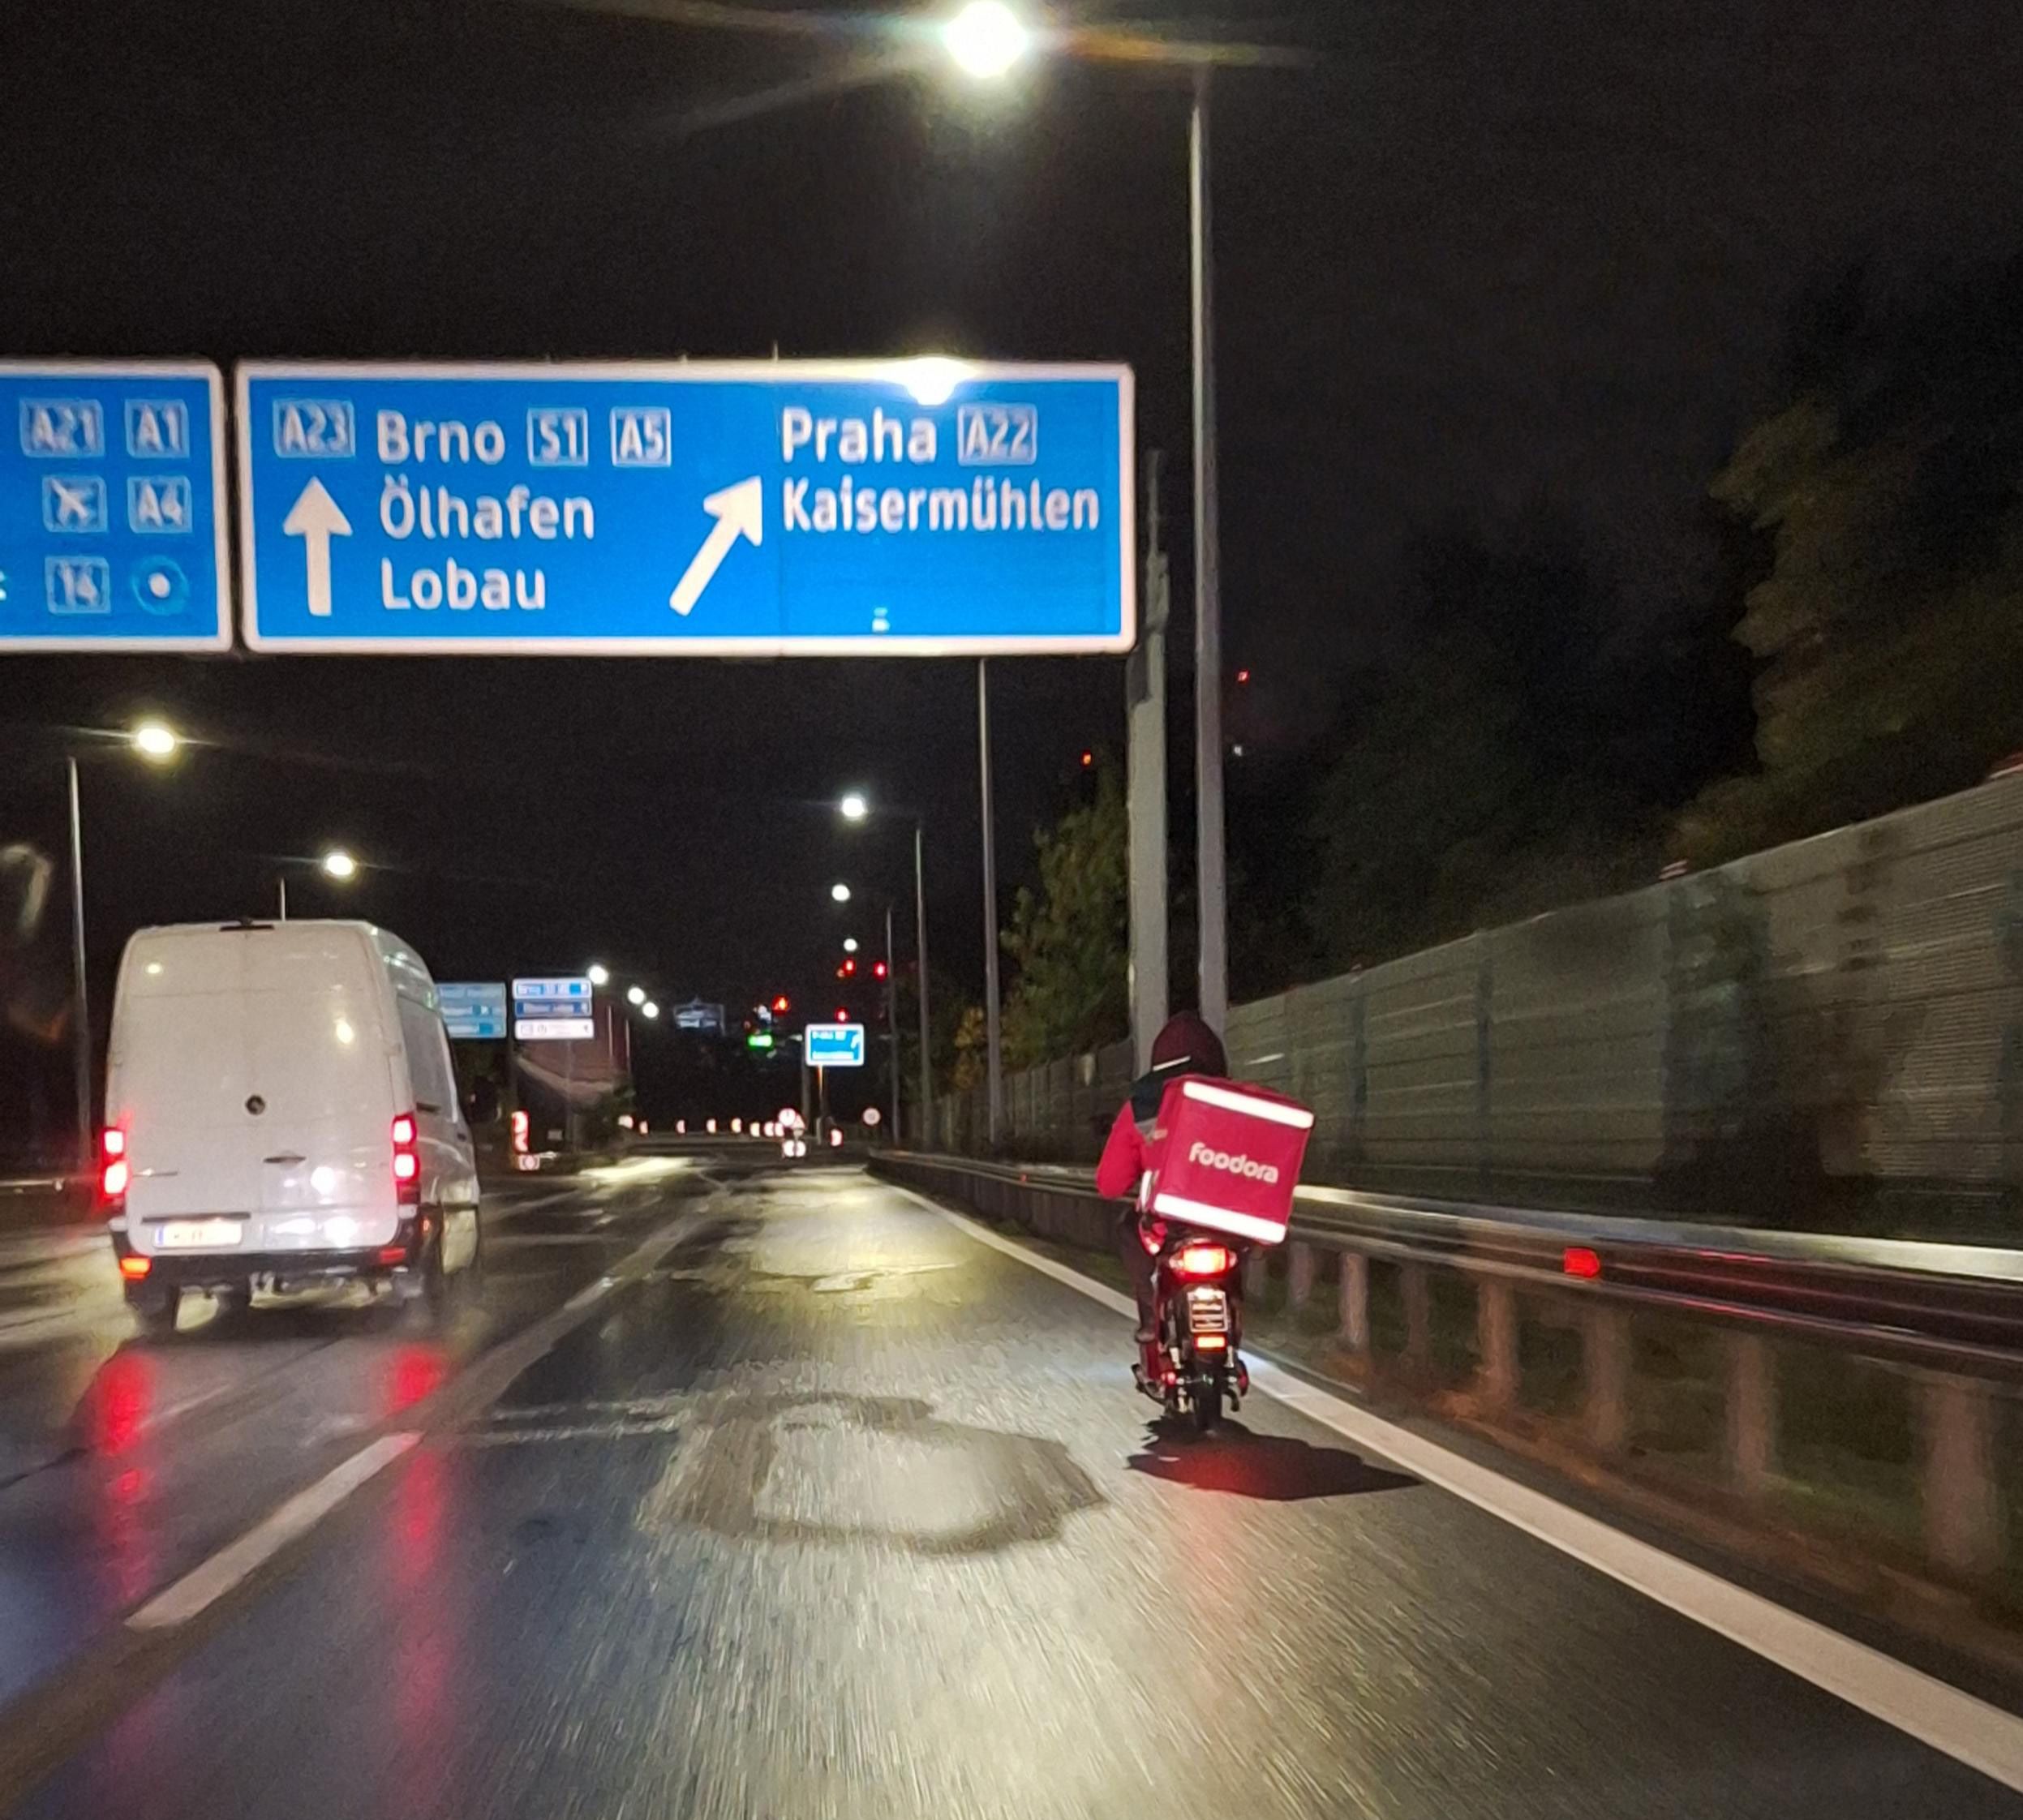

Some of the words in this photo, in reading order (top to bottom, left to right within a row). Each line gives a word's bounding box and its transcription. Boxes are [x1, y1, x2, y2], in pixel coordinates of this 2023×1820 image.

[136, 404, 181, 452] A1
[283, 404, 349, 455] A23
[376, 410, 505, 465] Brno
[539, 413, 578, 460] S1
[619, 413, 664, 461] A5
[783, 407, 937, 463] Praha
[965, 410, 1032, 460] A22
[138, 481, 183, 526] A4
[379, 471, 595, 539] Ölhafen
[783, 474, 1099, 533] Kaisermühlen
[381, 557, 546, 611] Lobau
[1188, 1141, 1279, 1184] foodora
